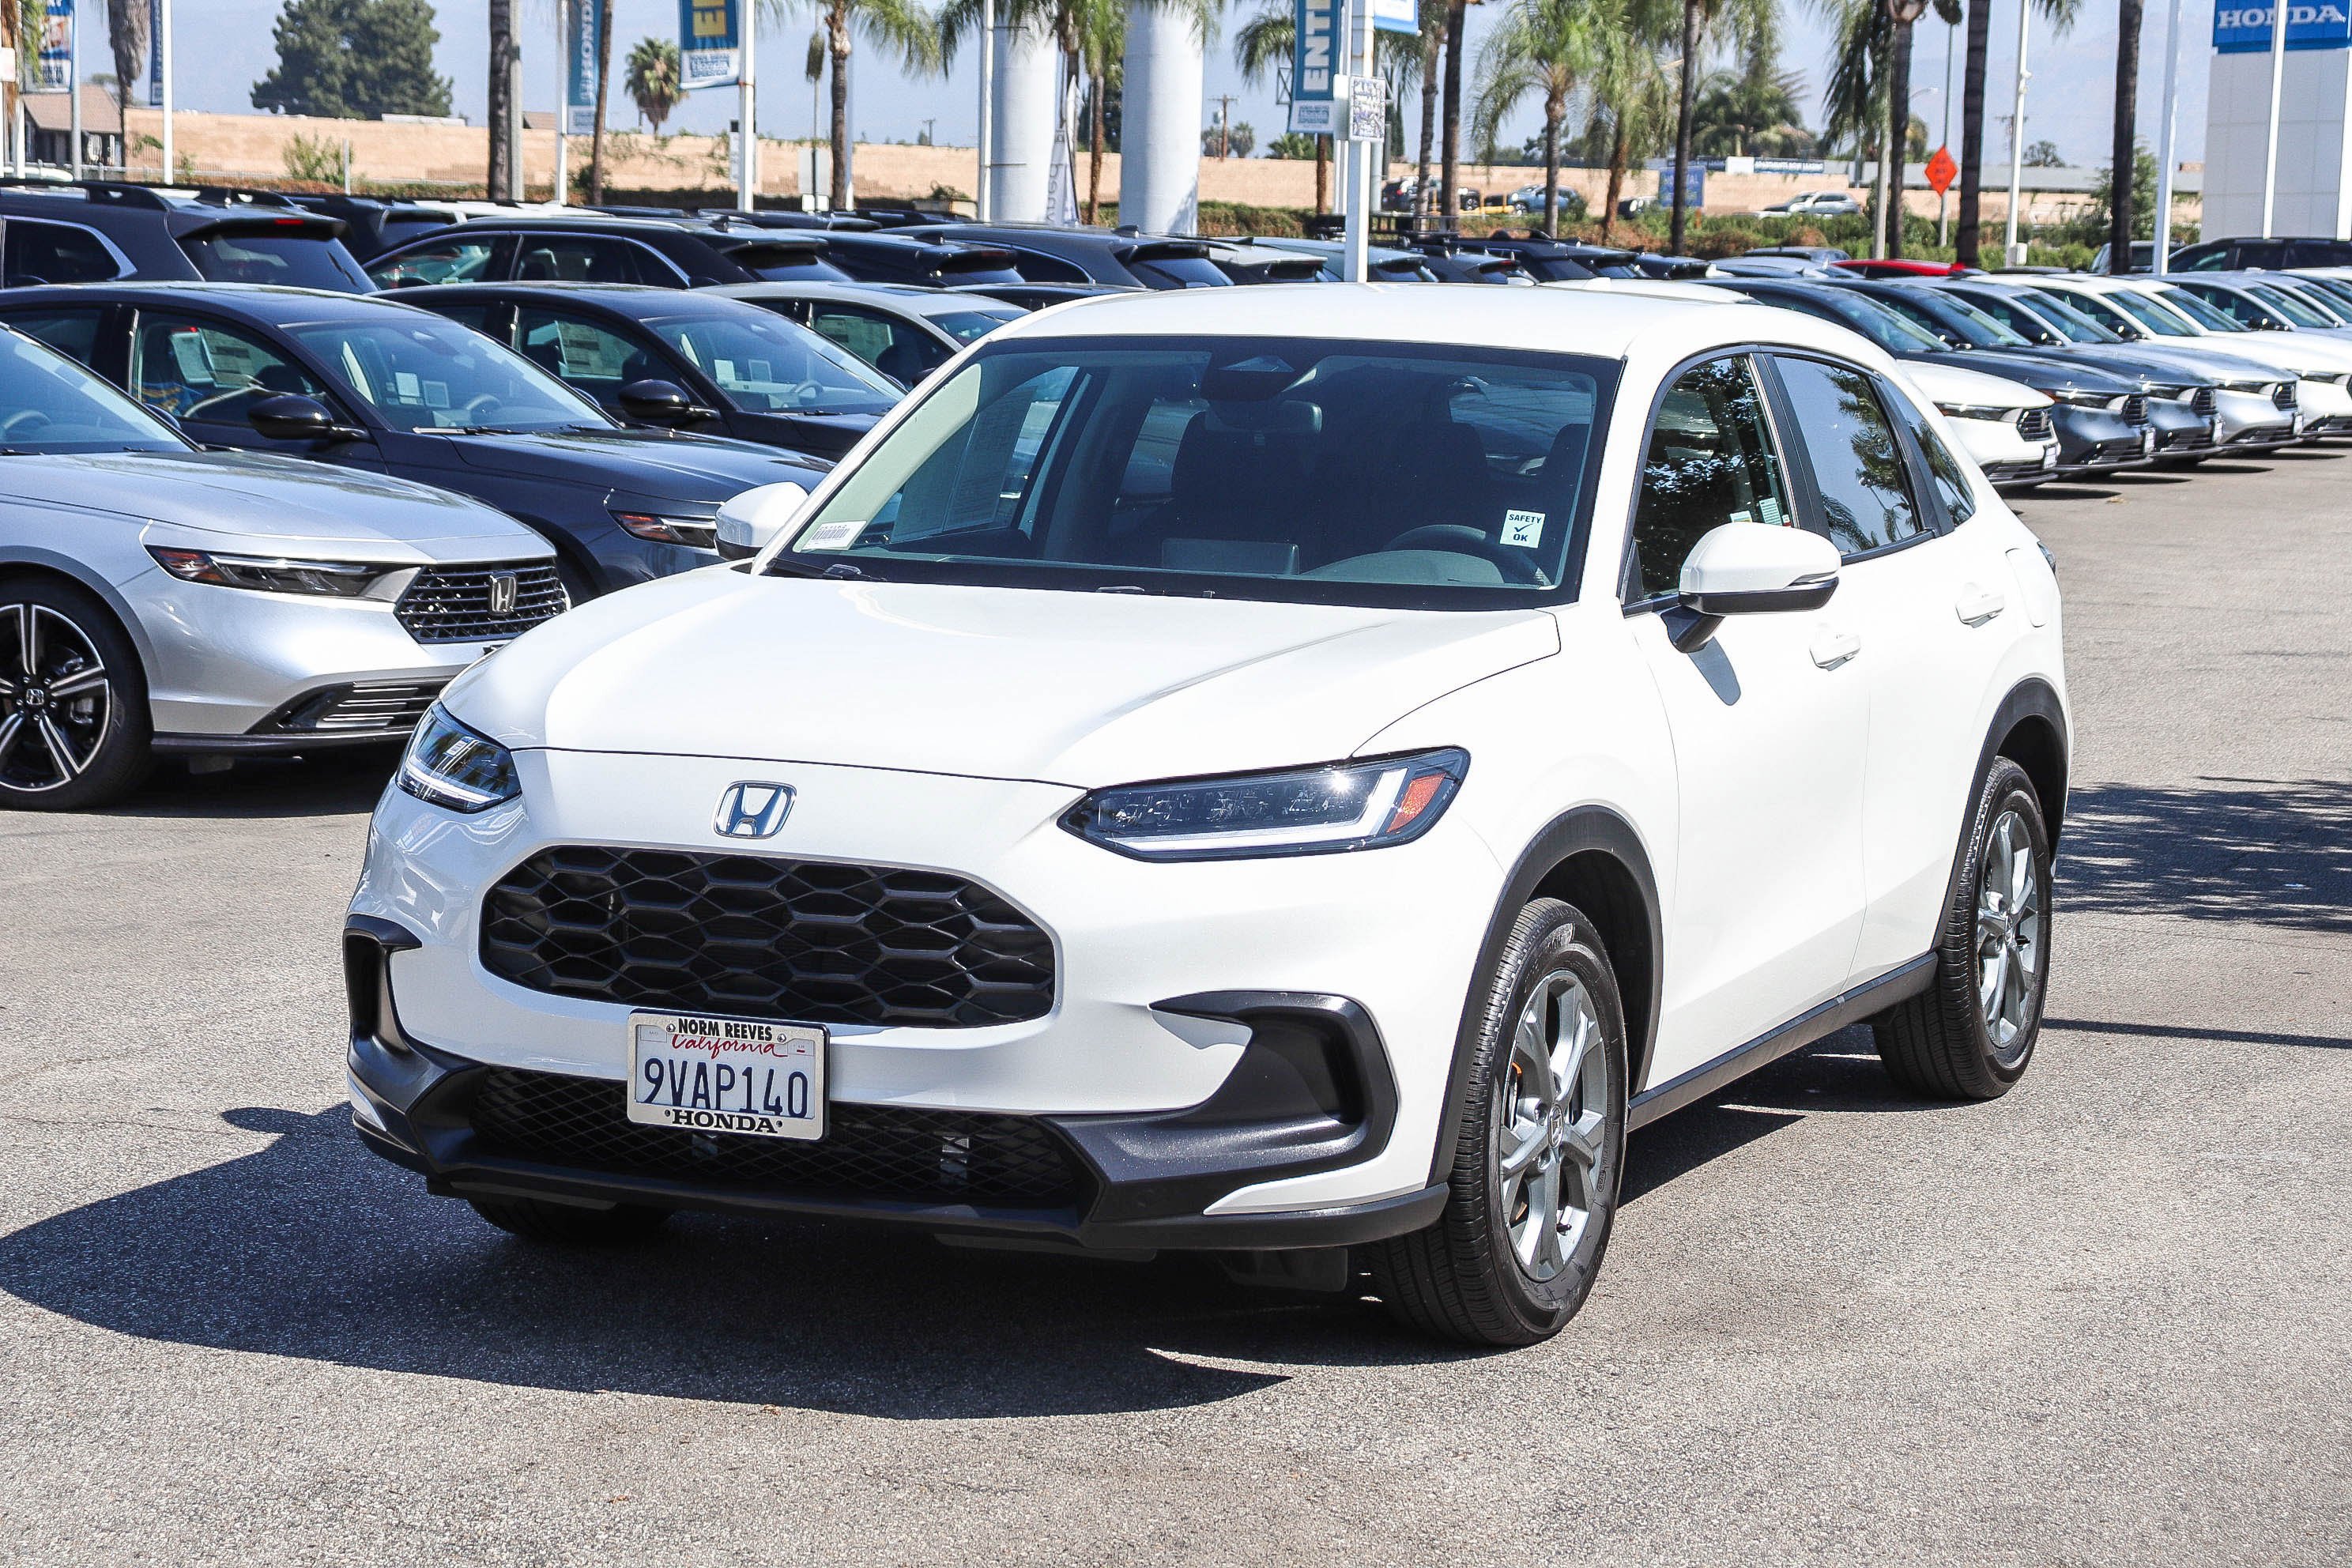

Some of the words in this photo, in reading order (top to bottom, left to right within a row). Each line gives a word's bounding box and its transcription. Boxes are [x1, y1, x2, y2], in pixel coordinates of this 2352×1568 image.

[581, 0, 594, 78] HOND
[1509, 514, 1543, 523] SAFETY
[1513, 533, 1528, 542] OK
[678, 1018, 720, 1037] NORM
[725, 1022, 773, 1042] REEVES
[672, 1034, 788, 1059] California
[644, 1057, 808, 1118] 9VAP140
[672, 1109, 778, 1134] HONDA
